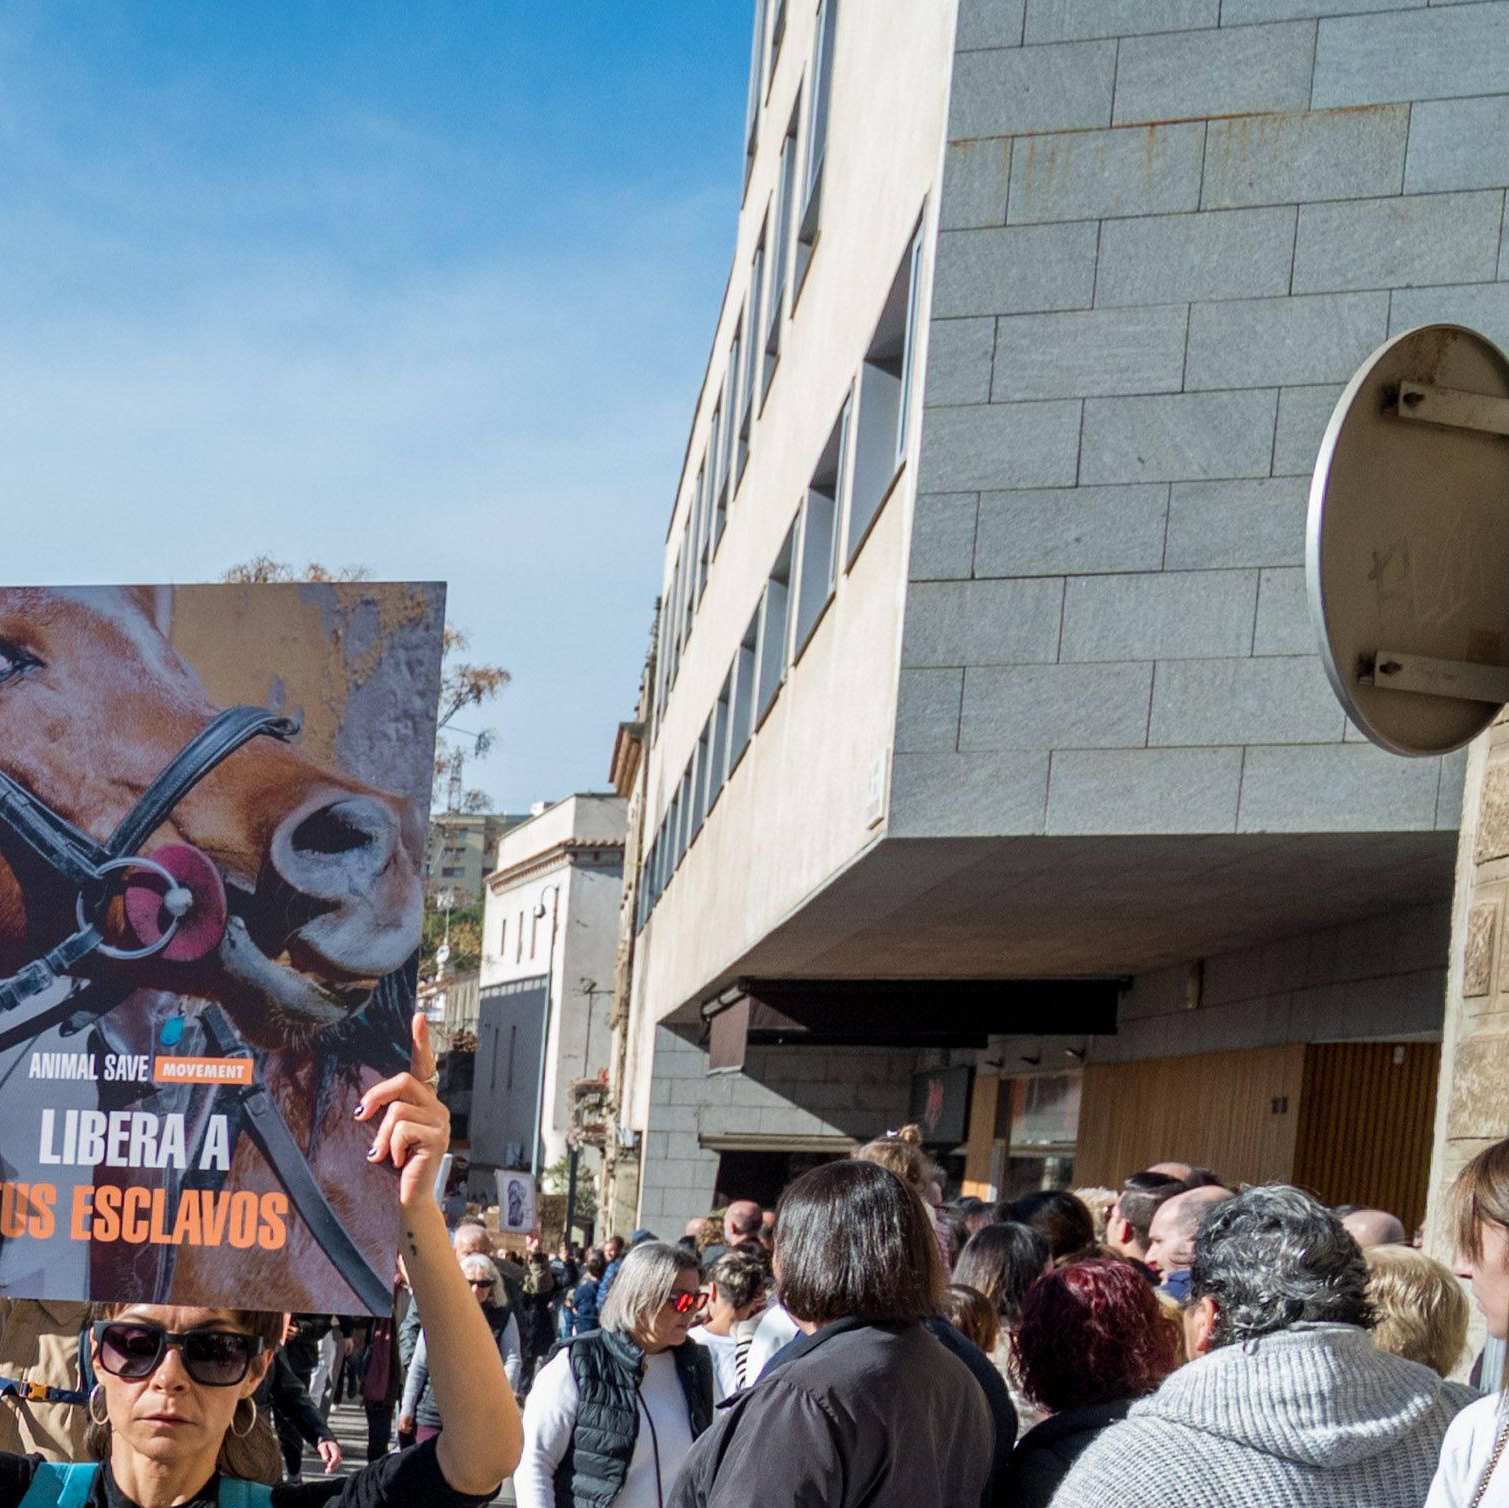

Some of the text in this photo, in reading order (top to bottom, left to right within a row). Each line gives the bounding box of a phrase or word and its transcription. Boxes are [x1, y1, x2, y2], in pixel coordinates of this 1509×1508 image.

[28, 1053, 245, 1082] ANIMAL SAVE MOVEMENT
[39, 1109, 231, 1171] LIBERA A
[70, 1185, 289, 1250] ESCLAVOS
